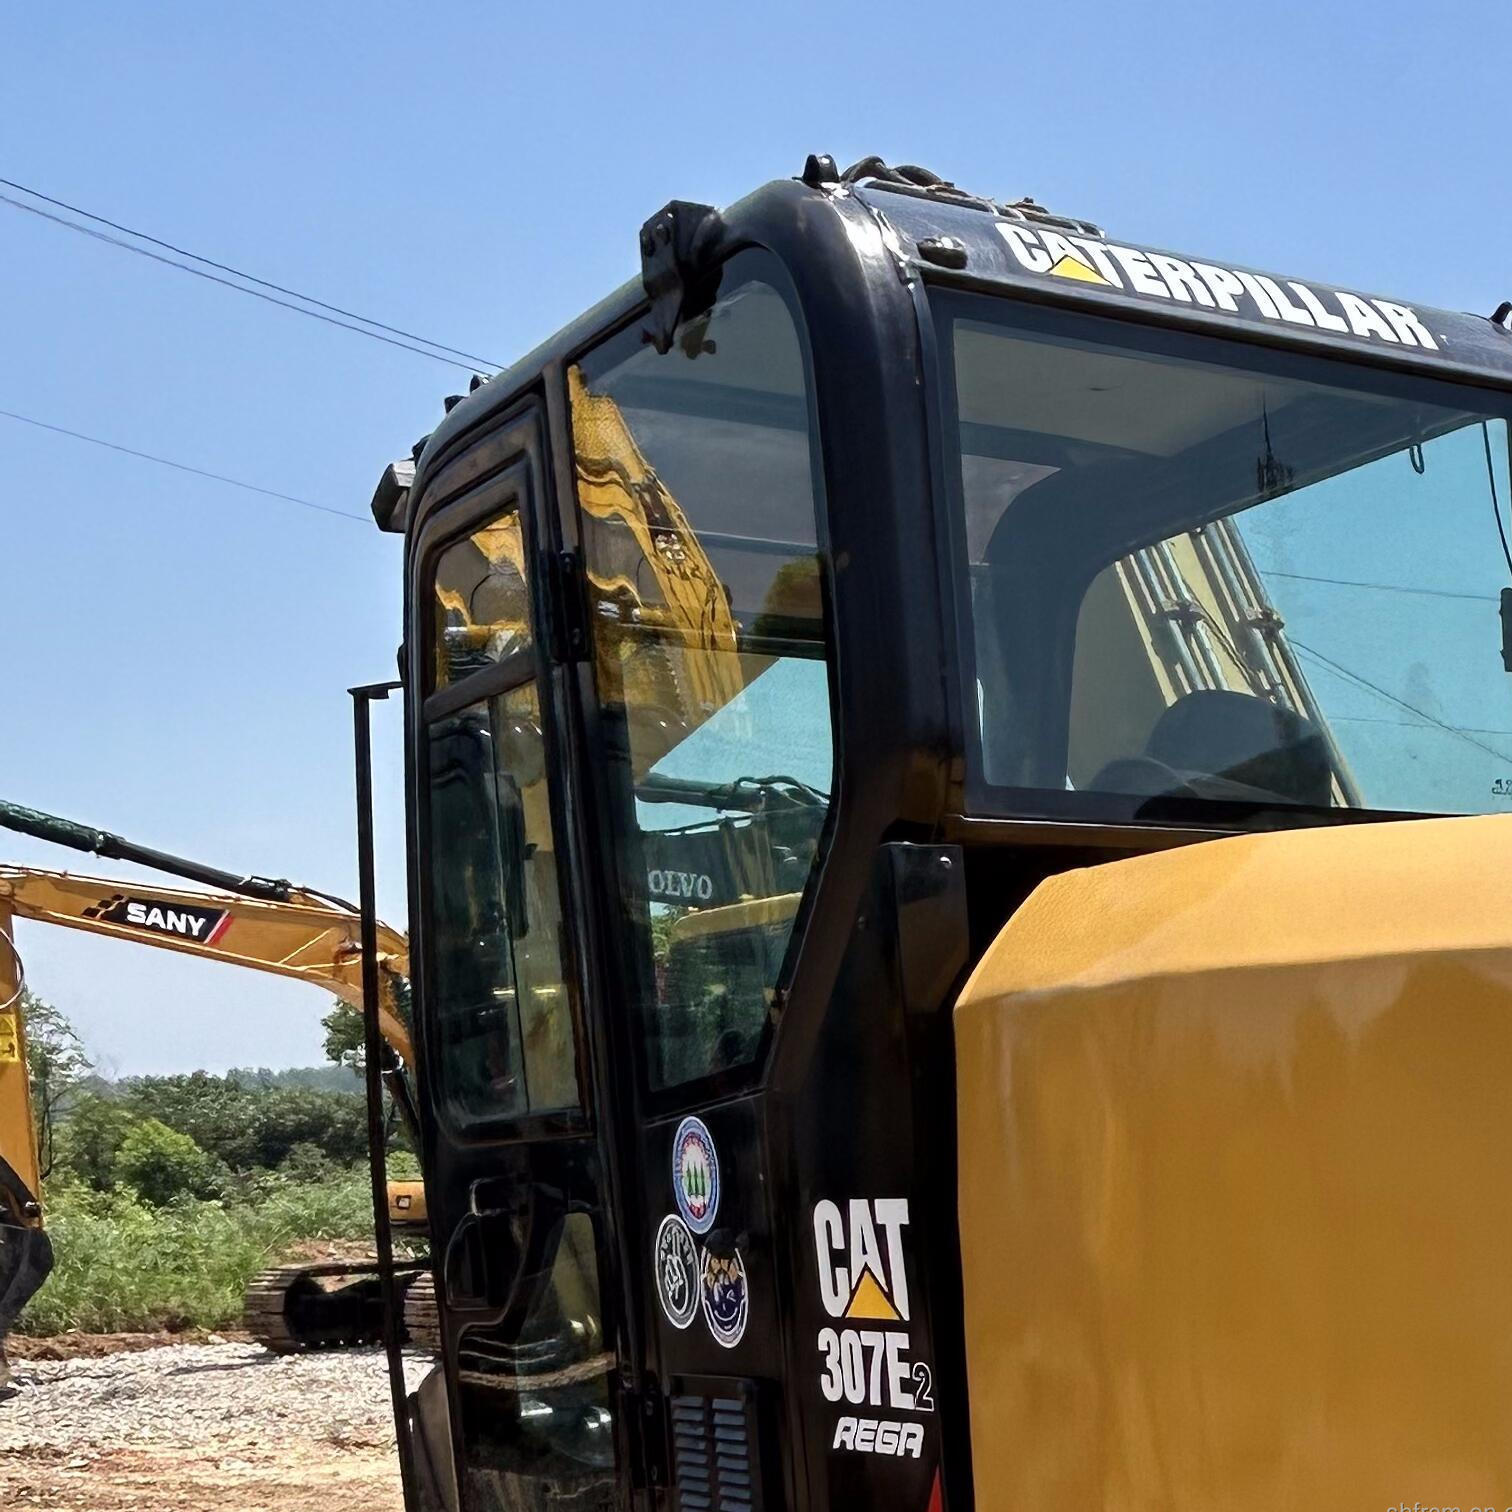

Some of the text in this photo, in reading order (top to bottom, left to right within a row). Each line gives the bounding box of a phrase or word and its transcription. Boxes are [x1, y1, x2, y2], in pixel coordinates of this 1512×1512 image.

[995, 221, 1440, 351] CATERPILLAR
[647, 869, 713, 899] OLVO
[127, 902, 206, 936] SANY
[812, 1197, 910, 1321] CAT
[832, 1416, 925, 1459] REGA
